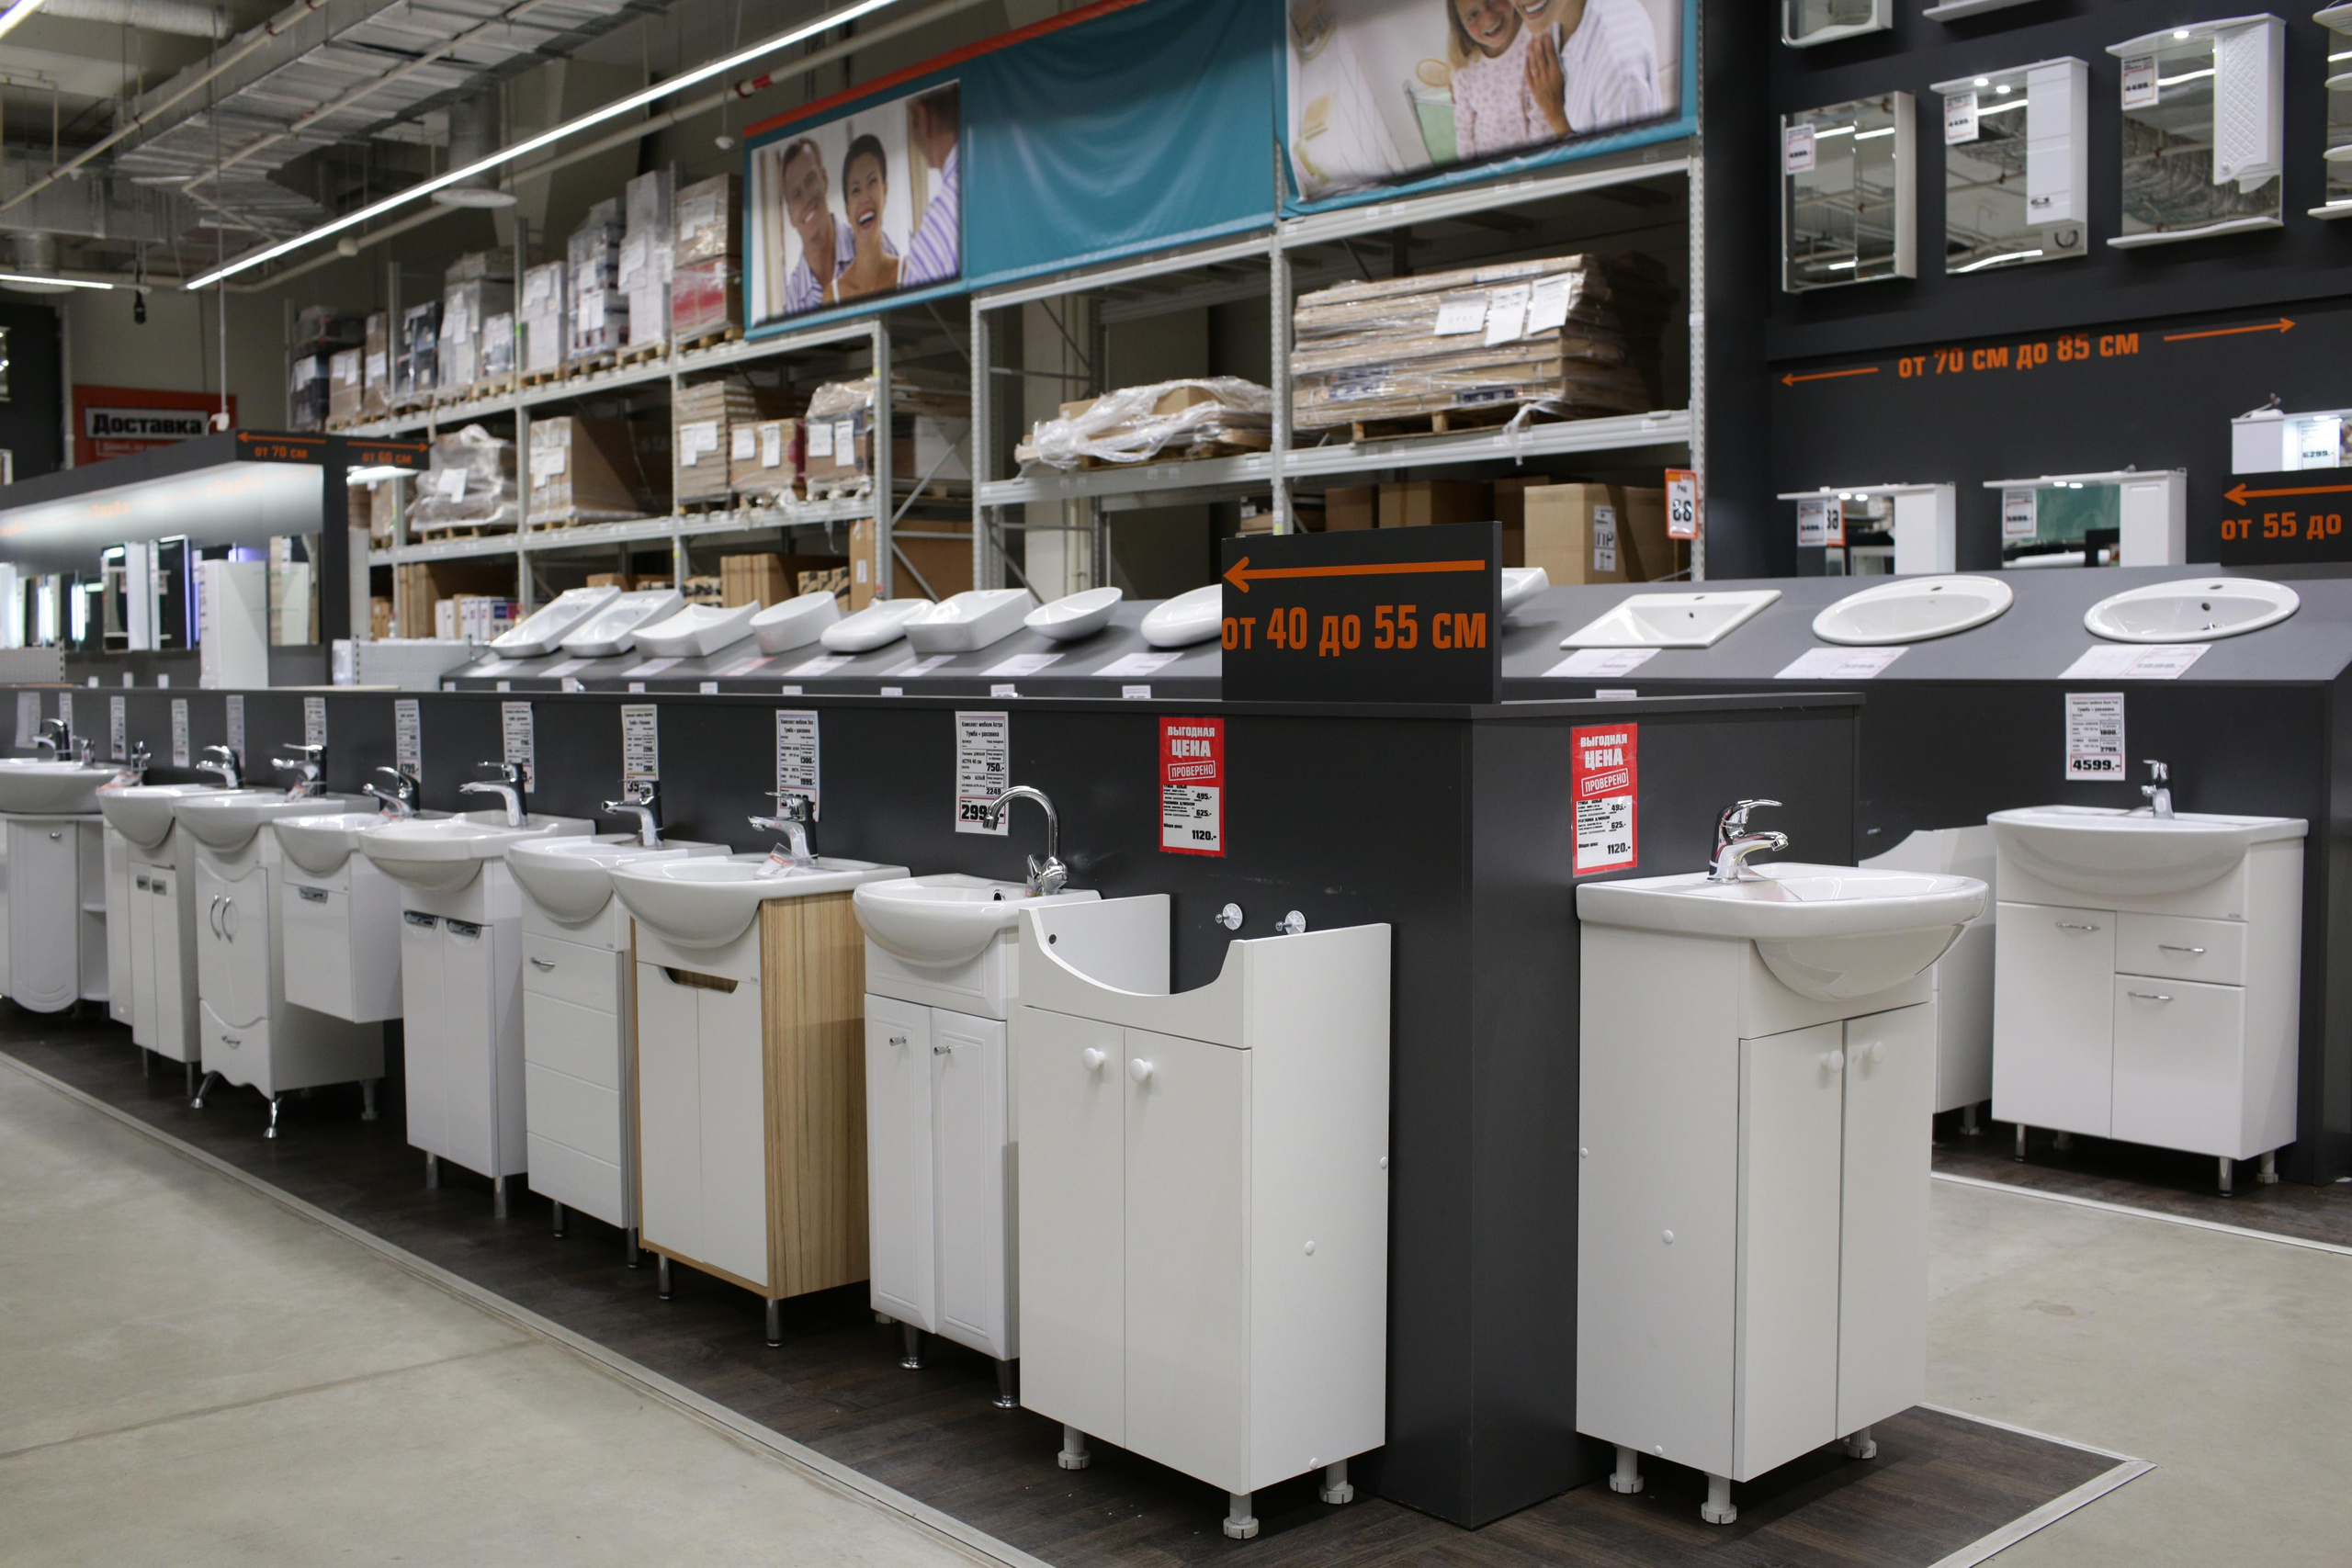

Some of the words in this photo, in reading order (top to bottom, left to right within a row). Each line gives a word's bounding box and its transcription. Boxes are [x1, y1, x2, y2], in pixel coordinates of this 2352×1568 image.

[1898, 356, 1926, 378] от
[1933, 347, 1964, 375] 70
[1972, 347, 2008, 370] см
[2016, 343, 2049, 370] до
[2057, 333, 2090, 361] 85
[2099, 333, 2139, 356] см
[93, 413, 202, 434] Доставка
[254, 446, 268, 458] от
[2221, 519, 2252, 540] от
[2263, 512, 2297, 538] 55
[2306, 513, 2342, 540] до
[1222, 616, 1256, 650] от
[1266, 606, 1307, 650] 40
[1318, 614, 1361, 657] до
[1374, 604, 1418, 649] 55
[1432, 612, 1487, 649] см
[1167, 726, 1216, 738] ВЫГОДНАЯ
[1580, 733, 1627, 748] ВЫГОДНАЯ
[1171, 739, 1211, 758] ЦЕНА
[987, 762, 1004, 773] 750.-
[1585, 748, 1623, 771] ЦЕНА
[2073, 760, 2120, 771] 4599.-
[1171, 763, 1214, 778] ПРОВЕРЕНО
[1585, 772, 1627, 793] ПРОВЕРЕНО
[1611, 821, 1626, 829] 625.-
